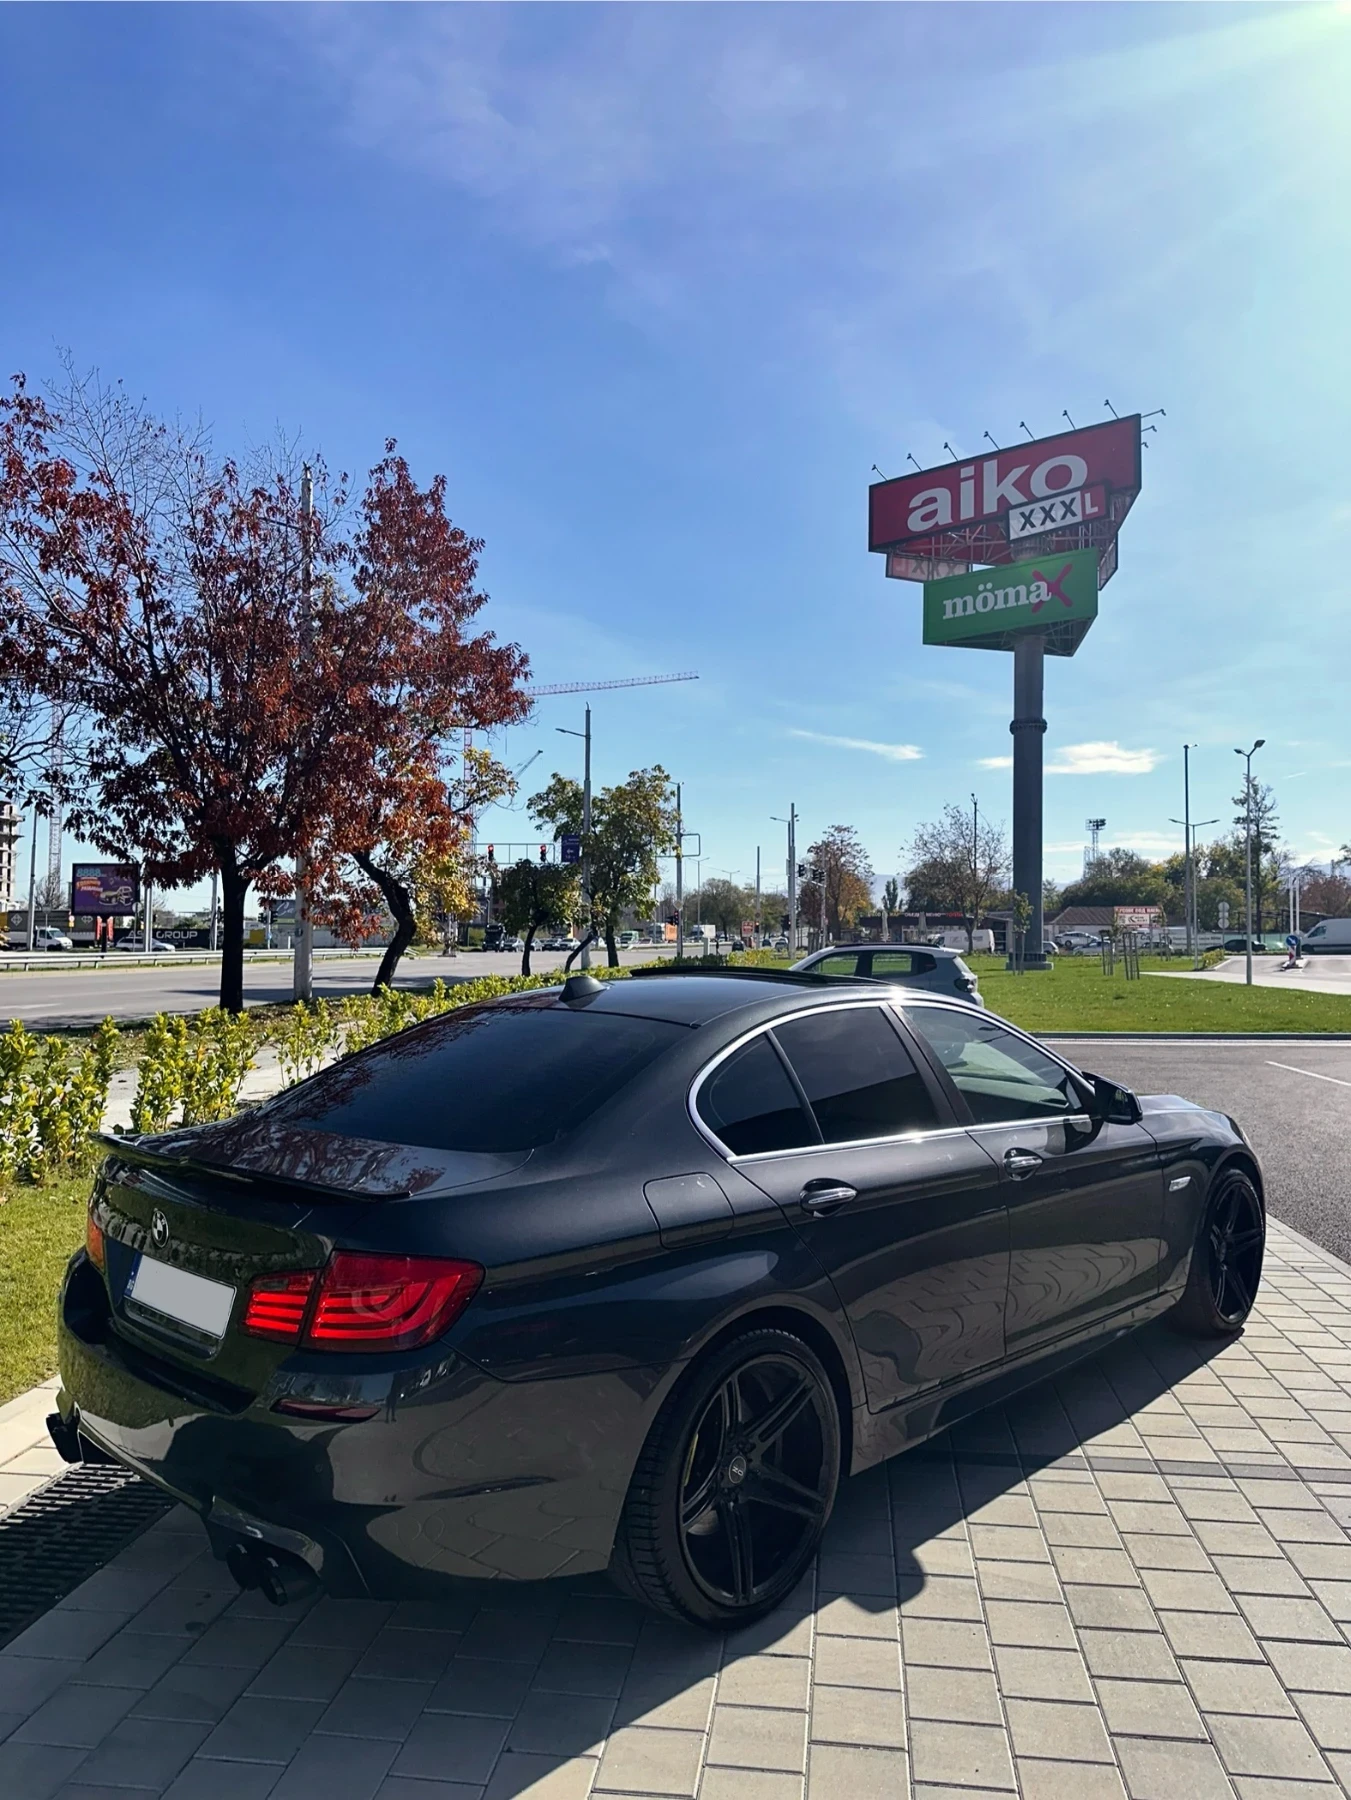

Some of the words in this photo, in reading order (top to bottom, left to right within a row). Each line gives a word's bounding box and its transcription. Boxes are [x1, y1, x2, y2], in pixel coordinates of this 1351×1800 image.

[907, 455, 1088, 532] aiko
[1019, 492, 1099, 532] XXXL
[156, 931, 198, 939] GROUP
